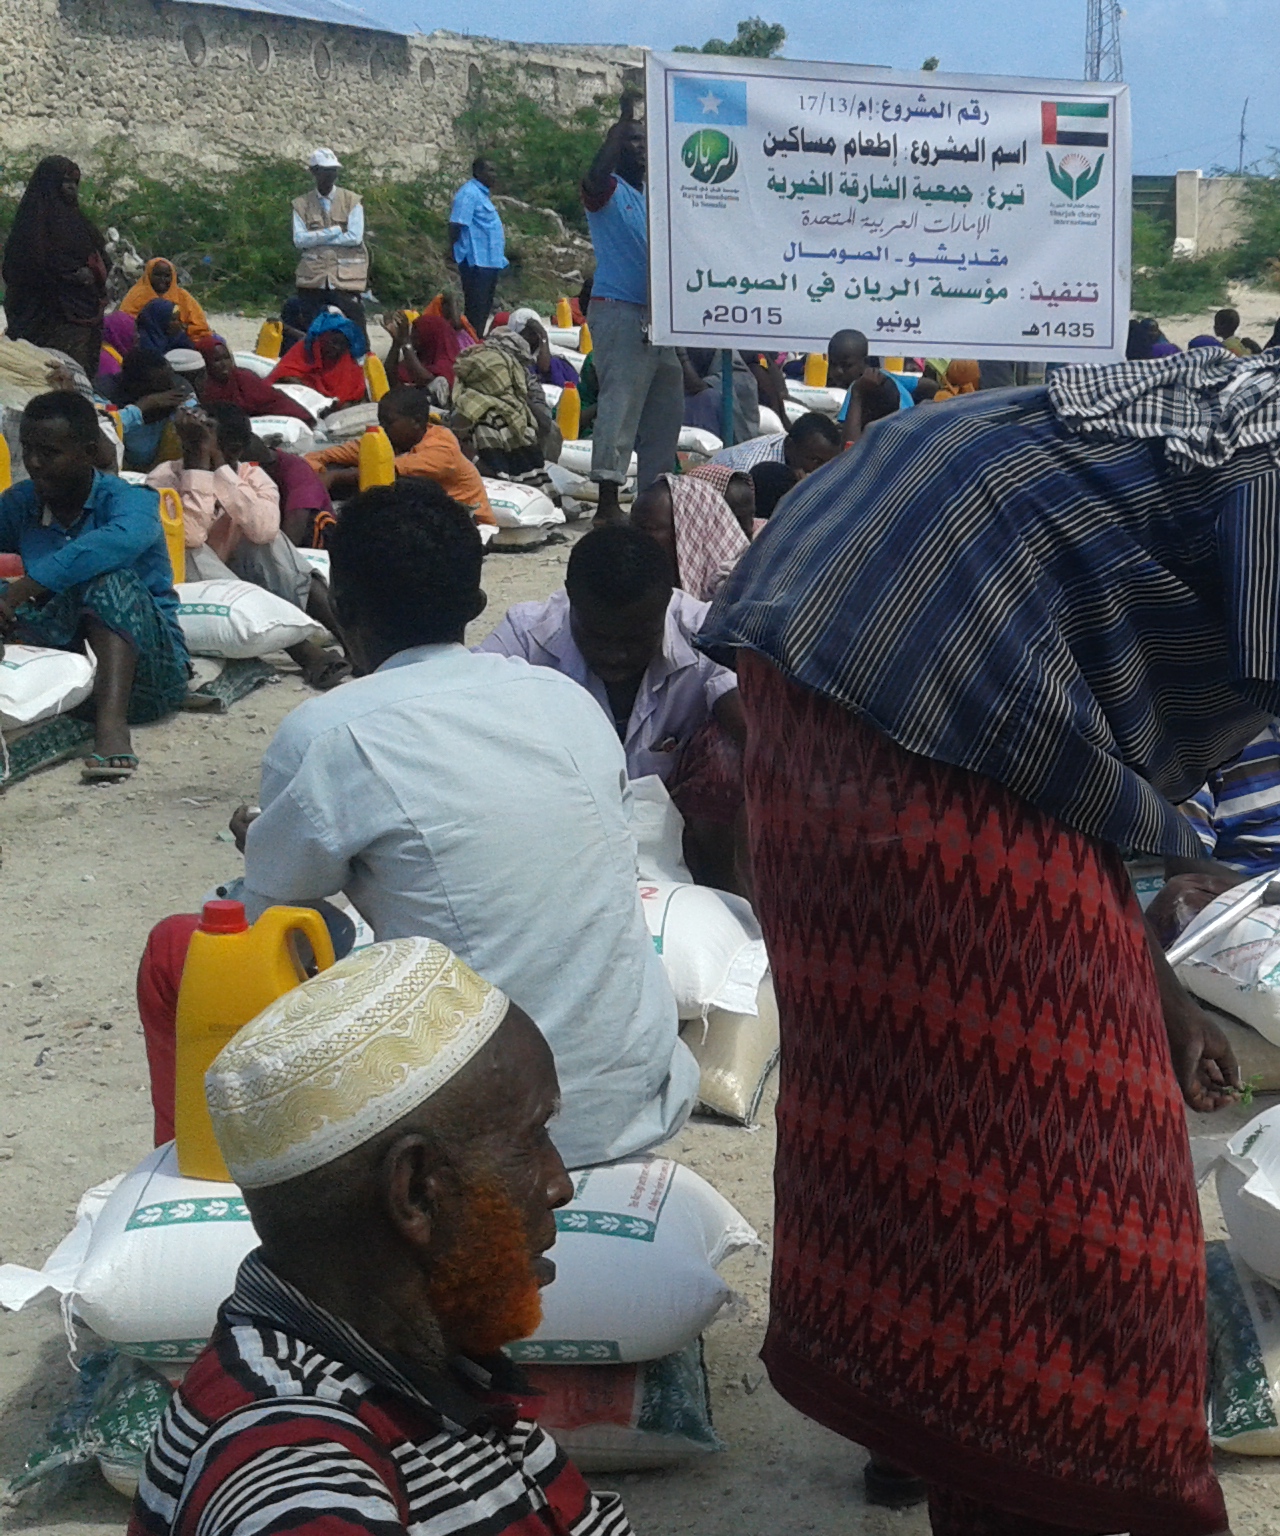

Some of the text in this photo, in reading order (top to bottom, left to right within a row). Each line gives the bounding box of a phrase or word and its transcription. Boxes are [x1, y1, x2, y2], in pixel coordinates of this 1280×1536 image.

[957, 98, 990, 125] رقم
[763, 126, 837, 158] مساكين
[843, 130, 898, 168] إطعام
[991, 139, 1028, 171] اسم
[767, 168, 833, 200] الخيرية
[839, 171, 907, 204] الشارقة
[912, 175, 973, 208] جمعية
[801, 207, 992, 240] الإمارات العربية المتحدة
[783, 241, 889, 264] الصومال
[907, 243, 1009, 271] مقديشو
[686, 268, 797, 295] الصومال
[806, 271, 835, 303] في
[844, 276, 920, 301] الريان
[928, 276, 1009, 305] مؤسسة
[875, 310, 922, 334] يونيو
